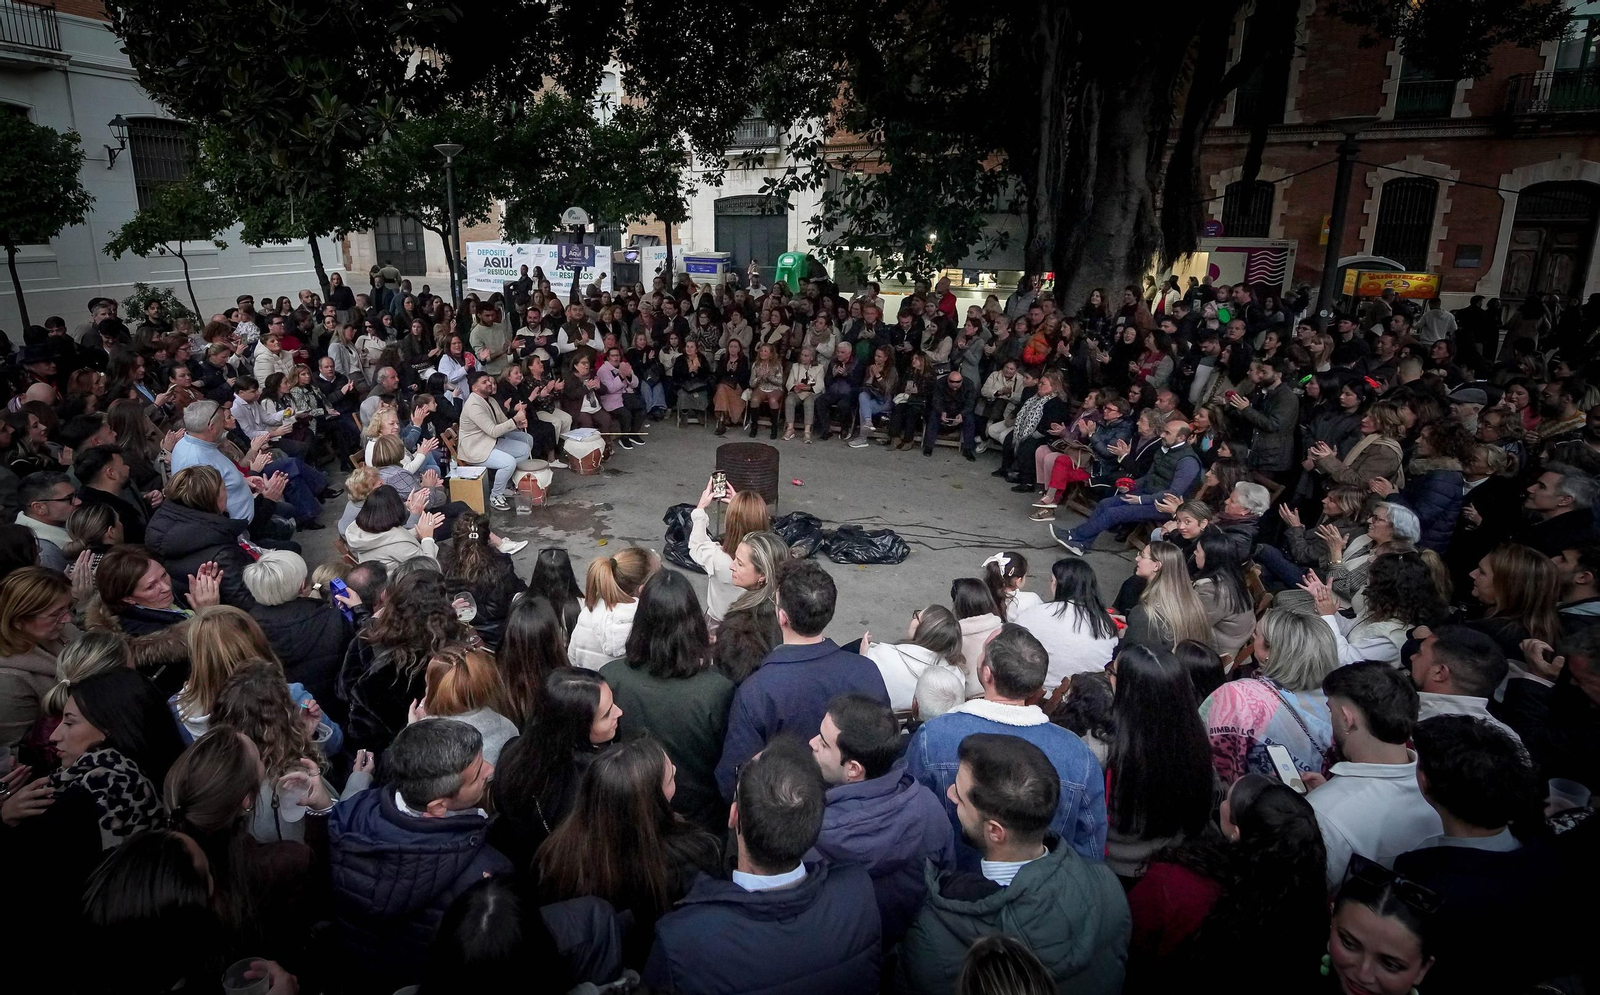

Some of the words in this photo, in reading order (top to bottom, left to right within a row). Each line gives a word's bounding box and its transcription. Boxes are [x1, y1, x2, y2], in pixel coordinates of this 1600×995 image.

[477, 248, 506, 256] DEPOSITE
[483, 254, 513, 268] AQUÍ
[487, 268, 518, 276] RESIDUOS
[559, 271, 594, 280] RESIUOS
[1210, 726, 1237, 735] BIMBA
